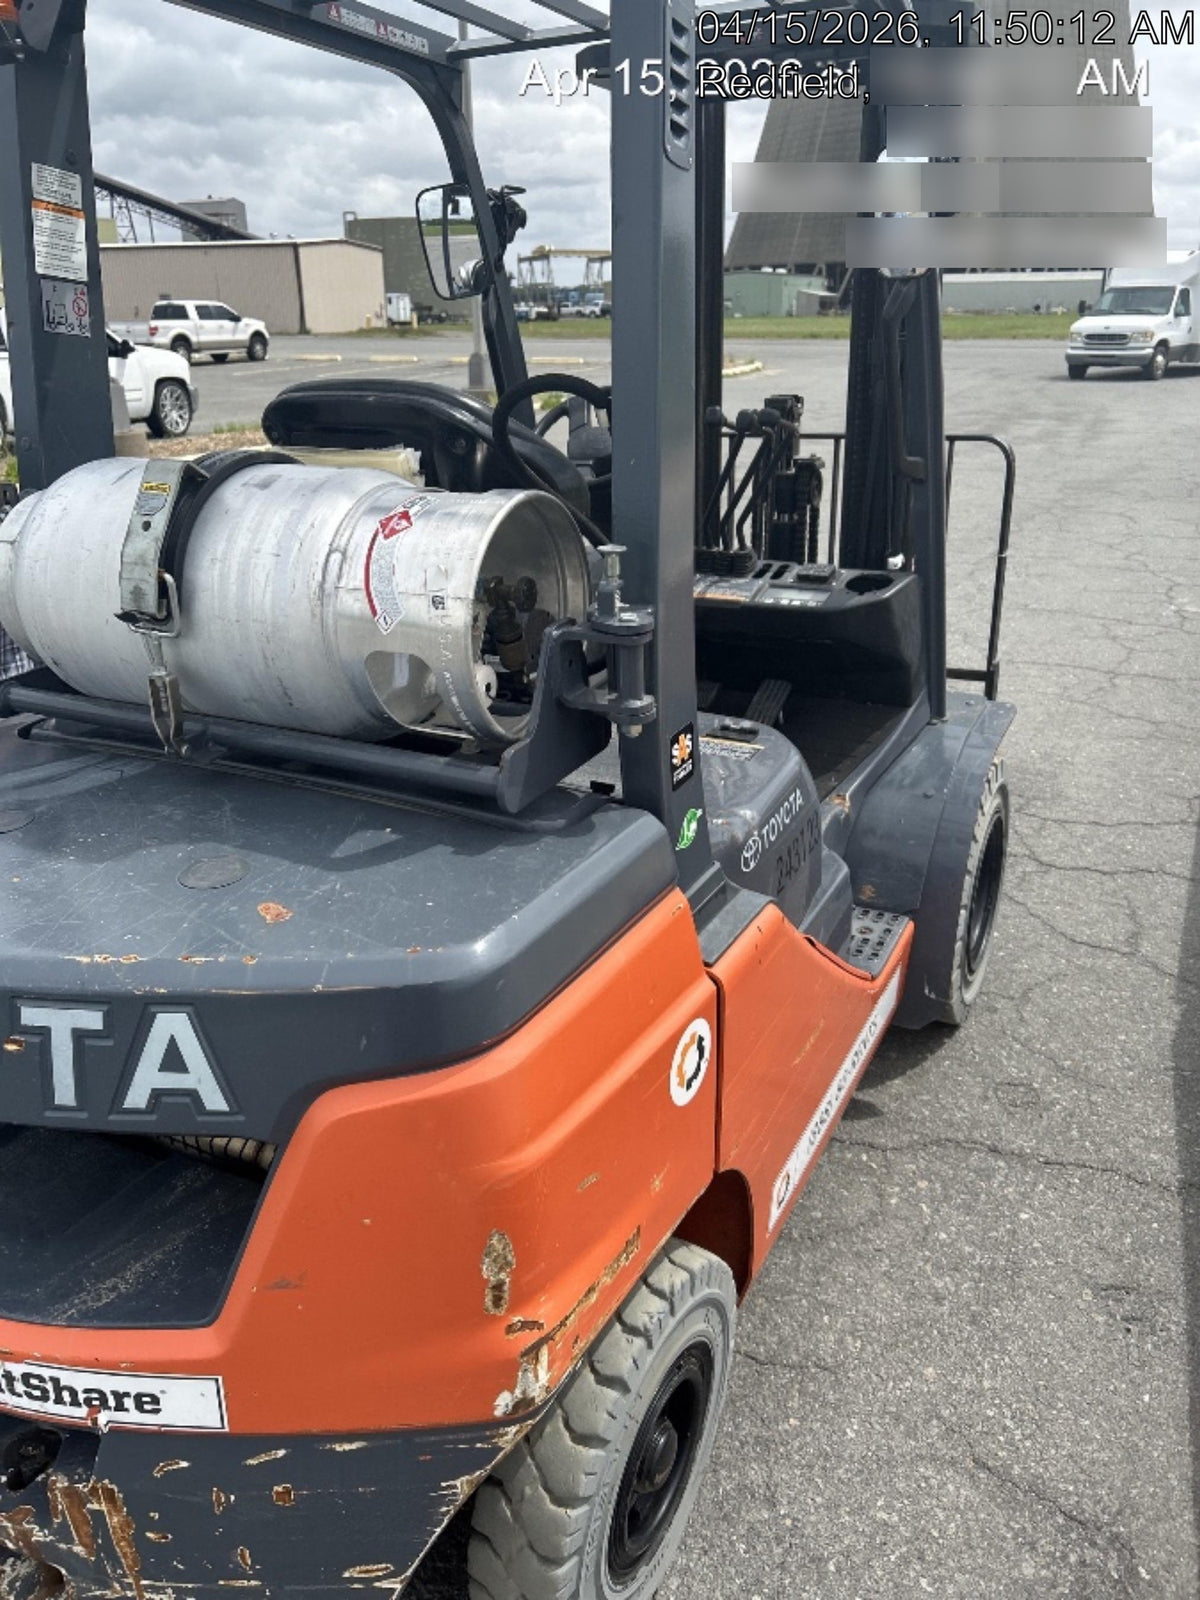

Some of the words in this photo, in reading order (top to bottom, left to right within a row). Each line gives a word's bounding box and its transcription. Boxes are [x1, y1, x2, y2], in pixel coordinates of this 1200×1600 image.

[761, 787, 804, 848] TOYOTA
[20, 1005, 231, 1112] TA
[0, 1370, 162, 1414] tShare
